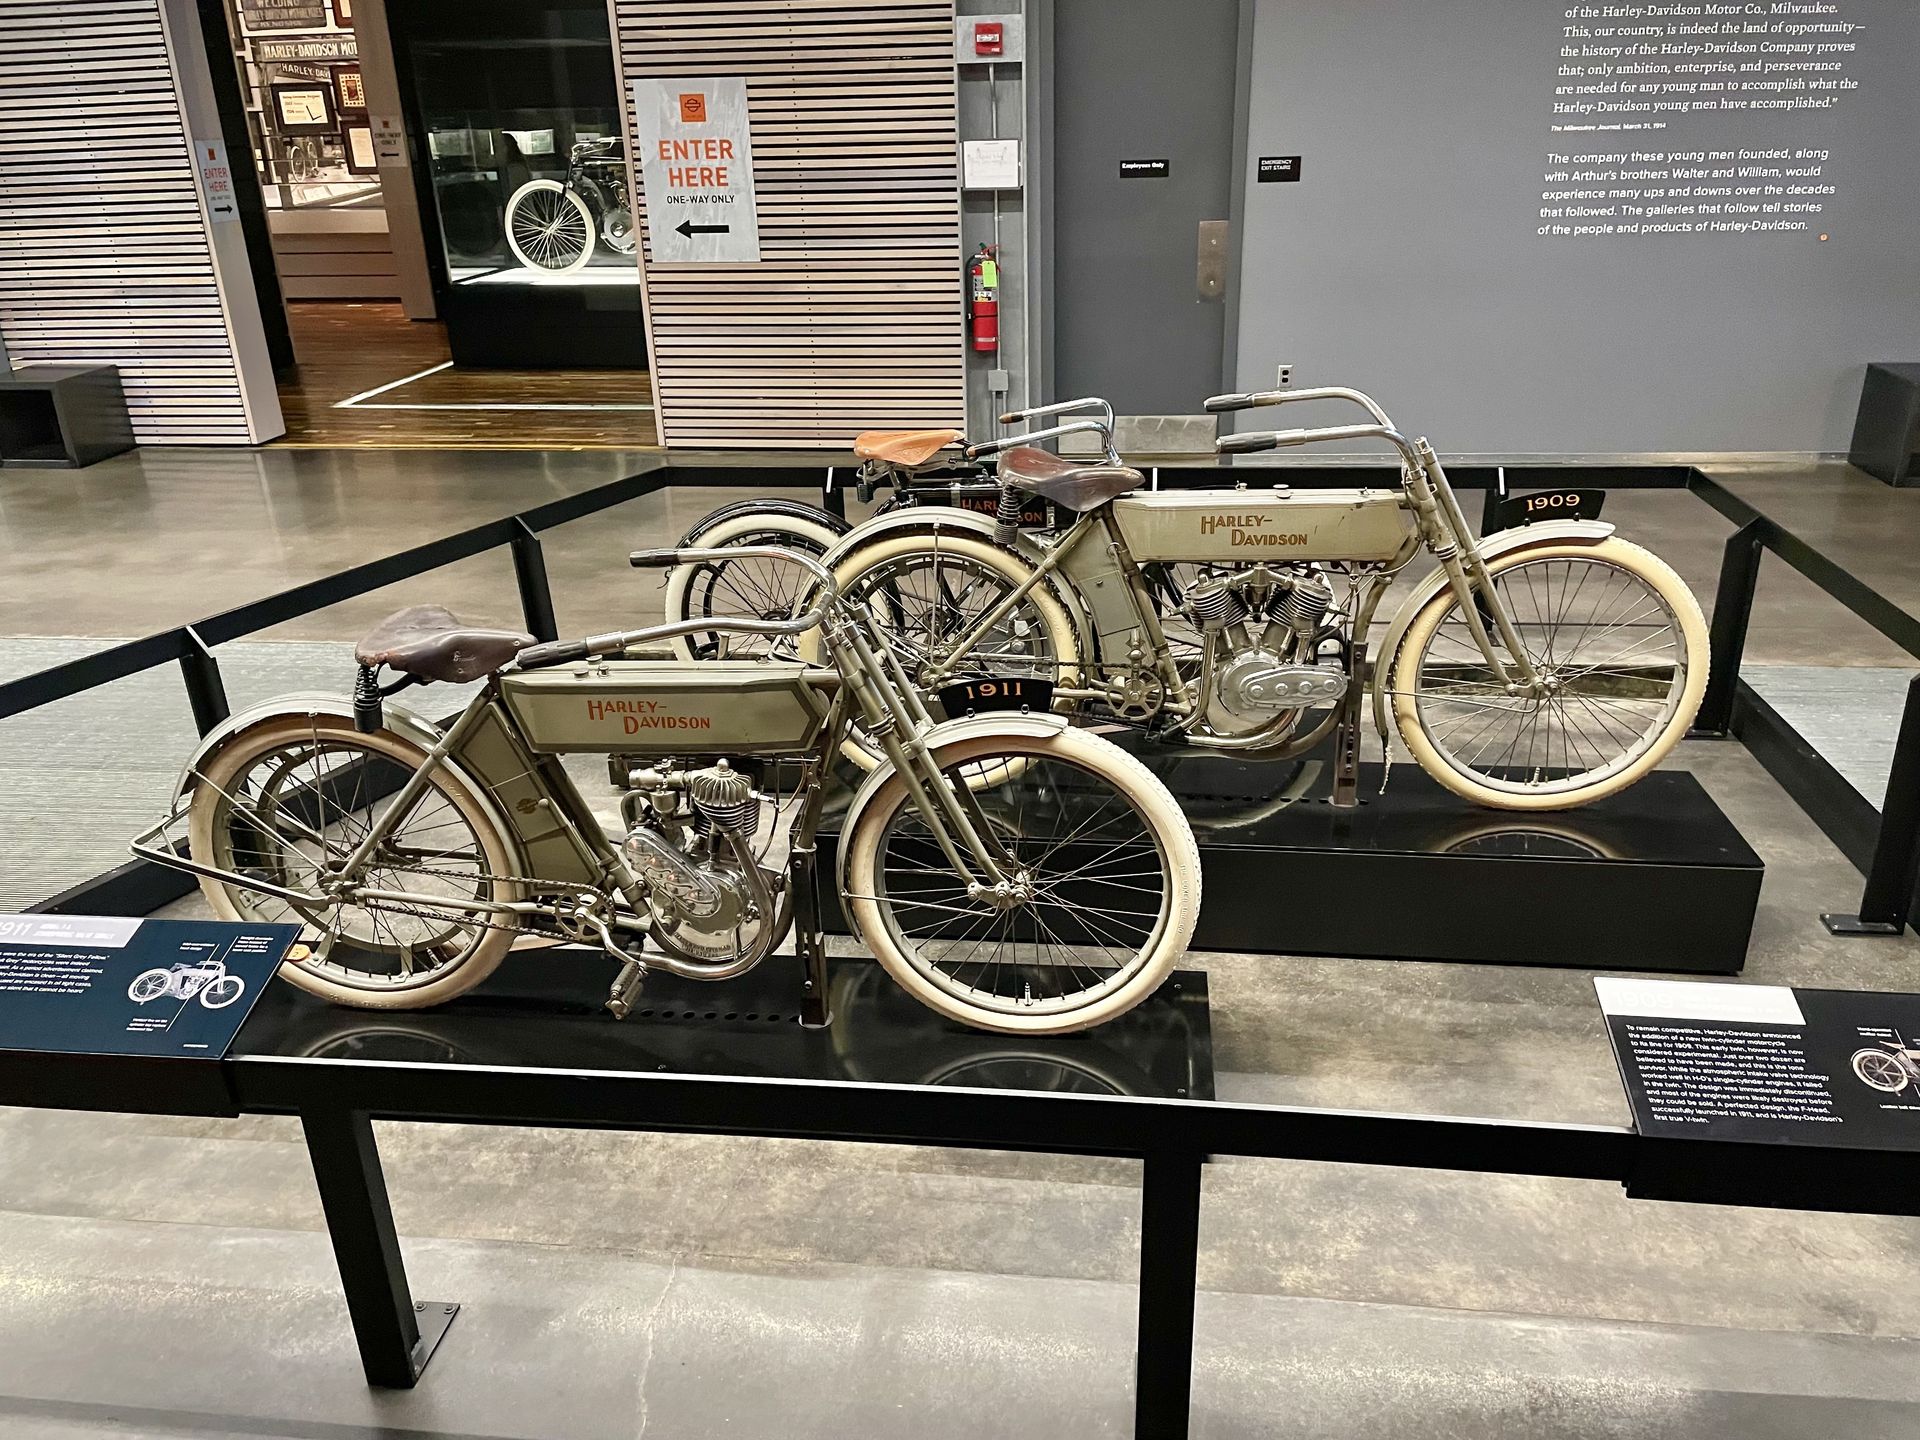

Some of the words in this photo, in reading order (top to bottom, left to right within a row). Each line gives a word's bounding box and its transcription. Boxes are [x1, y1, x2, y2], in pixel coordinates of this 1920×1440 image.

[1565, 7, 1579, 18] of
[1580, 5, 1600, 18] the
[1602, 3, 1701, 17] Harley-Davidson
[1704, 4, 1741, 14] Motor
[1745, 2, 1767, 15] Co.,
[1770, 1, 1838, 13] Milwaukee.
[1563, 25, 1591, 38] This,
[1594, 28, 1614, 36] our
[1617, 25, 1663, 37] country,
[1666, 23, 1676, 34] is
[1679, 22, 1718, 34] indeed
[1721, 22, 1739, 33] the
[1742, 21, 1768, 33] land
[1771, 21, 1783, 32] of
[264, 43, 339, 58] HARLEY-DAVIDSON
[1561, 44, 1579, 57] the
[1582, 43, 1622, 58] history
[1625, 43, 1638, 54] of
[1639, 42, 1657, 54] the
[1660, 40, 1757, 56] Harley-Davidson
[1760, 41, 1815, 54] Company
[1816, 42, 1855, 54] proves
[1558, 64, 1584, 77] that;
[1587, 62, 1613, 77] only
[1616, 62, 1670, 74] ambition,
[1674, 60, 1736, 74] enterprise,
[1740, 59, 1761, 71] and
[1764, 62, 1841, 73] perseverance
[1555, 86, 1573, 94] are
[1575, 81, 1617, 93] needed
[1620, 81, 1636, 92] for
[1639, 84, 1660, 94] any
[1661, 83, 1697, 94] young
[1699, 82, 1723, 90] man
[1727, 81, 1738, 90] to
[1741, 78, 1805, 92] accomplish
[1809, 77, 1837, 89] what
[1840, 77, 1858, 88] the
[1553, 99, 1649, 114] Harley-Davidson
[1653, 102, 1689, 113] young
[1692, 101, 1716, 109] men
[1720, 97, 1747, 108] have
[658, 139, 734, 160] ENTER
[1547, 153, 1569, 163] The
[1573, 154, 1627, 164] company
[1631, 151, 1663, 161] these
[1667, 152, 1704, 163] young
[1708, 151, 1734, 159] men
[1738, 148, 1790, 159] founded,
[1795, 148, 1828, 160] along
[204, 168, 228, 179] ENTER
[668, 167, 729, 187] HERE
[1544, 171, 1568, 181] with
[1571, 170, 1617, 181] Arthur's
[1620, 169, 1668, 179] brothers
[1672, 168, 1708, 178] Walter
[1712, 167, 1734, 177] and
[1738, 166, 1781, 177] William,
[1786, 166, 1821, 176] would
[209, 181, 229, 192] HERE
[1542, 188, 1605, 201] experience
[1609, 189, 1640, 199] many
[1643, 189, 1664, 199] ups
[1668, 186, 1690, 196] and
[1693, 186, 1731, 195] downs
[1735, 187, 1760, 195] over
[1764, 184, 1783, 194] the
[1786, 184, 1835, 194] decades
[666, 195, 710, 204] ONE-WAY
[711, 194, 735, 204] ONLY
[1540, 207, 1562, 217] that
[1565, 205, 1617, 217] followed.
[1623, 205, 1642, 215] The
[1646, 204, 1694, 217] galleries
[1698, 203, 1720, 213] that
[1724, 203, 1759, 213] follow
[1763, 202, 1780, 212] tell
[1783, 202, 1821, 212] stories
[1538, 224, 1550, 235] of
[1552, 223, 1570, 235] the
[1574, 223, 1613, 236] people
[1617, 222, 1638, 233] and
[1641, 222, 1692, 235] products
[1695, 221, 1707, 231] of
[1710, 219, 1808, 233] Harley-Davidson.
[1526, 494, 1580, 512] 1909
[1201, 515, 1273, 535] HARLEY-
[1231, 529, 1308, 546] DAVIDSON
[966, 682, 1022, 700] 1911
[587, 700, 667, 721] HARLEY-
[624, 715, 711, 734] DAVIDSON
